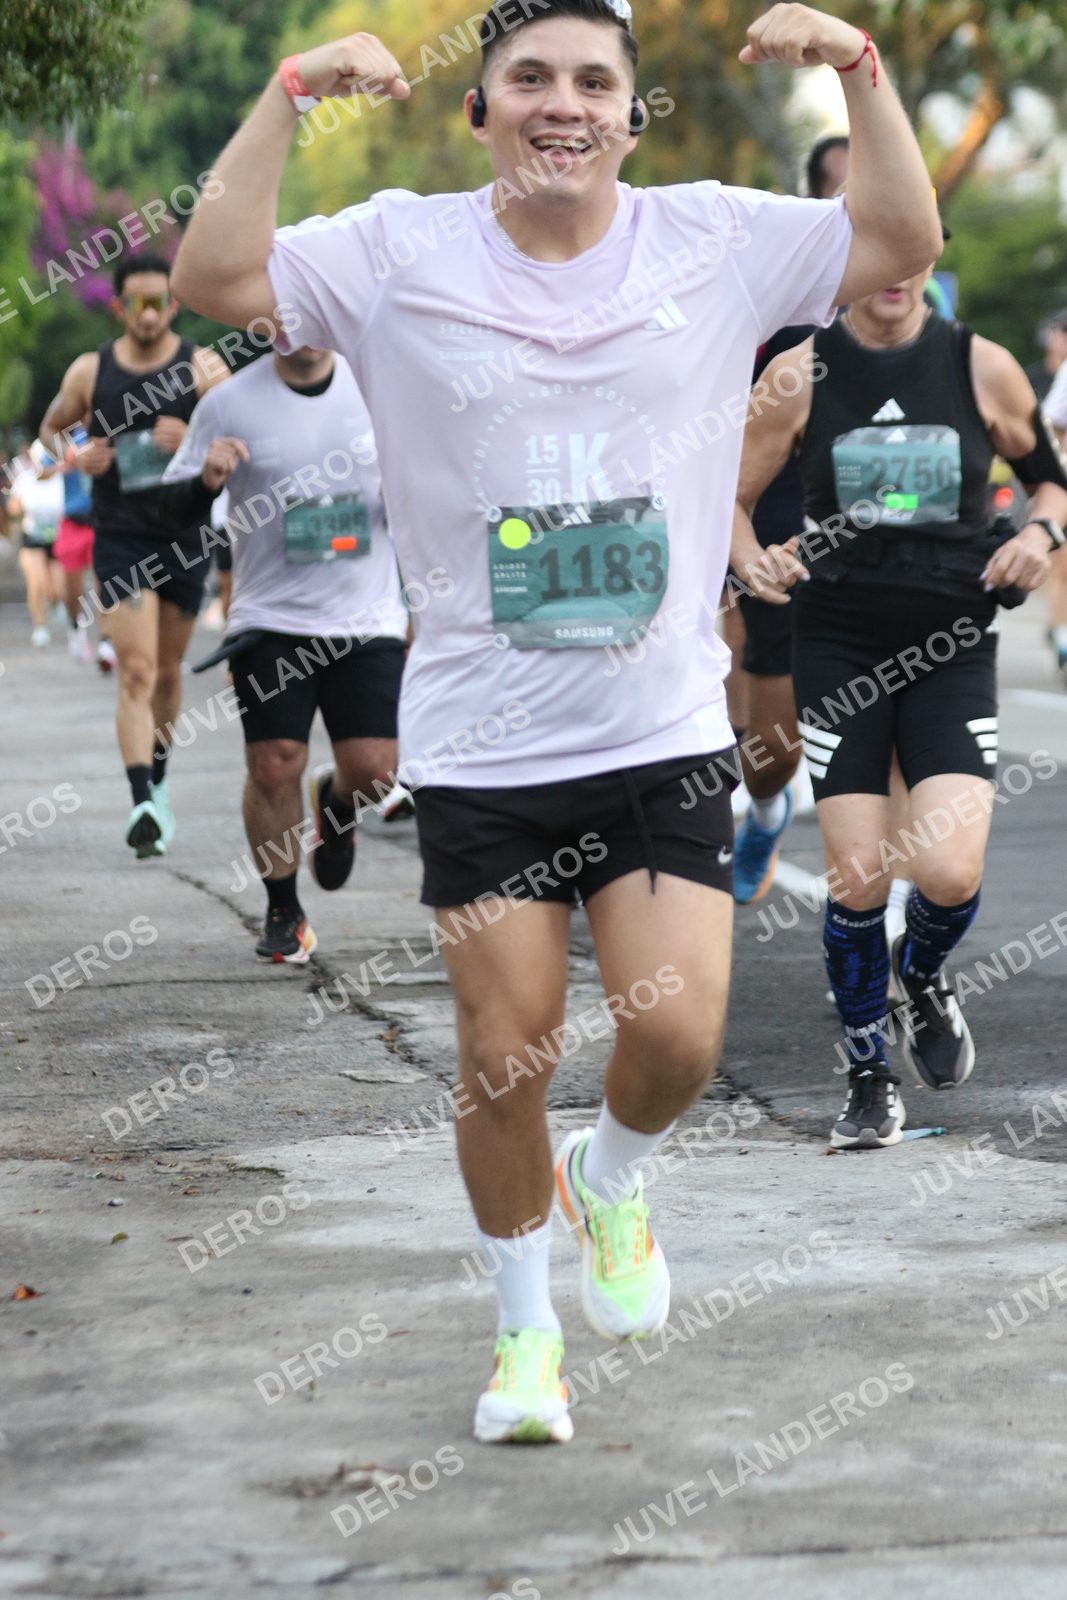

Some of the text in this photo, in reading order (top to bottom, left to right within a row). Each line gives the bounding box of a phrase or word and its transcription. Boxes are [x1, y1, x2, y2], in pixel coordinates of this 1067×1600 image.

[525, 434, 560, 464] 15
[568, 431, 612, 504] K
[527, 478, 561, 507] 30
[540, 540, 664, 600] 1183
[554, 625, 614, 639] SAMSUNG
